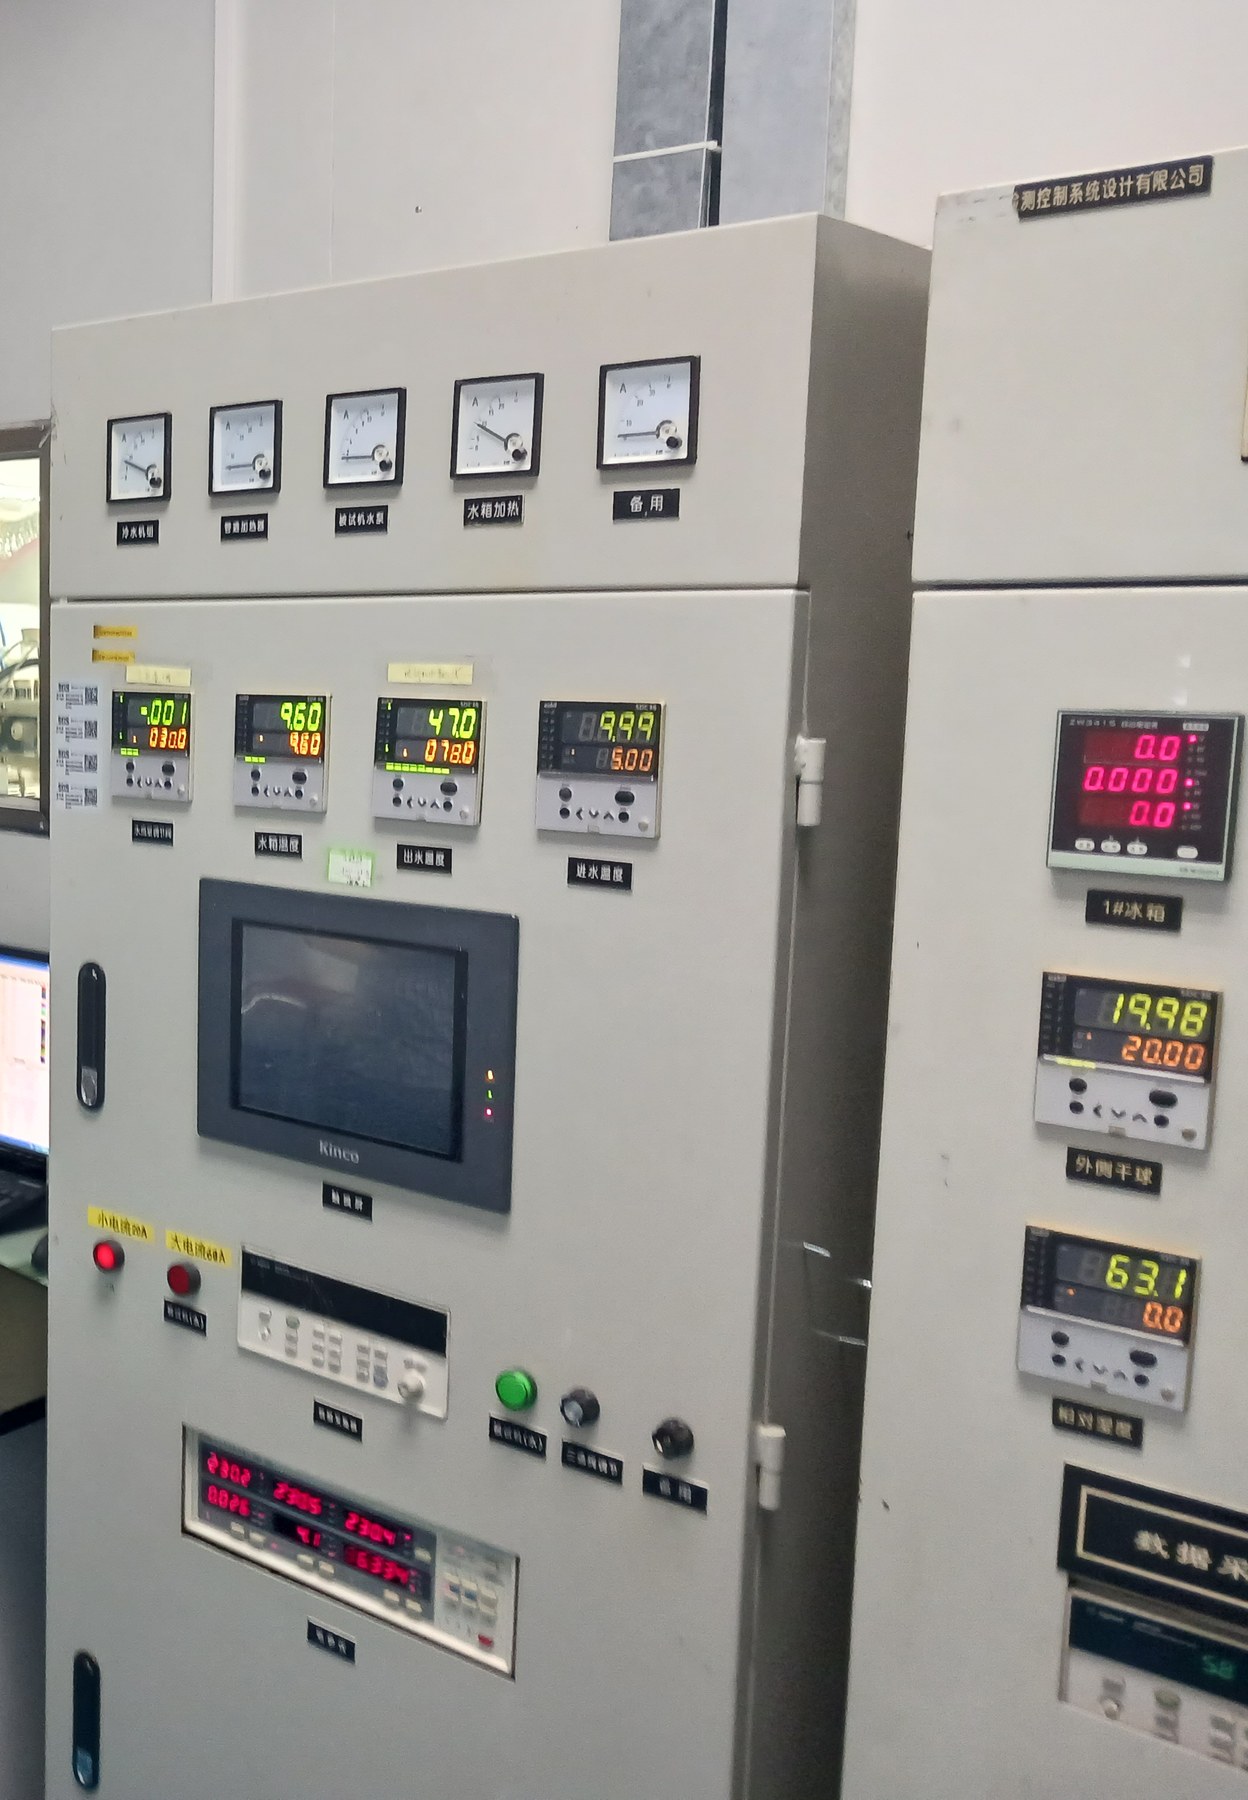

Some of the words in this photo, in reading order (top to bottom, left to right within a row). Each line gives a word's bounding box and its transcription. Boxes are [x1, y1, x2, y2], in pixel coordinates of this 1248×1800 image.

[467, 500, 519, 519] 水箱加热
[630, 494, 664, 513] 备用
[319, 1140, 360, 1164] Kinco
